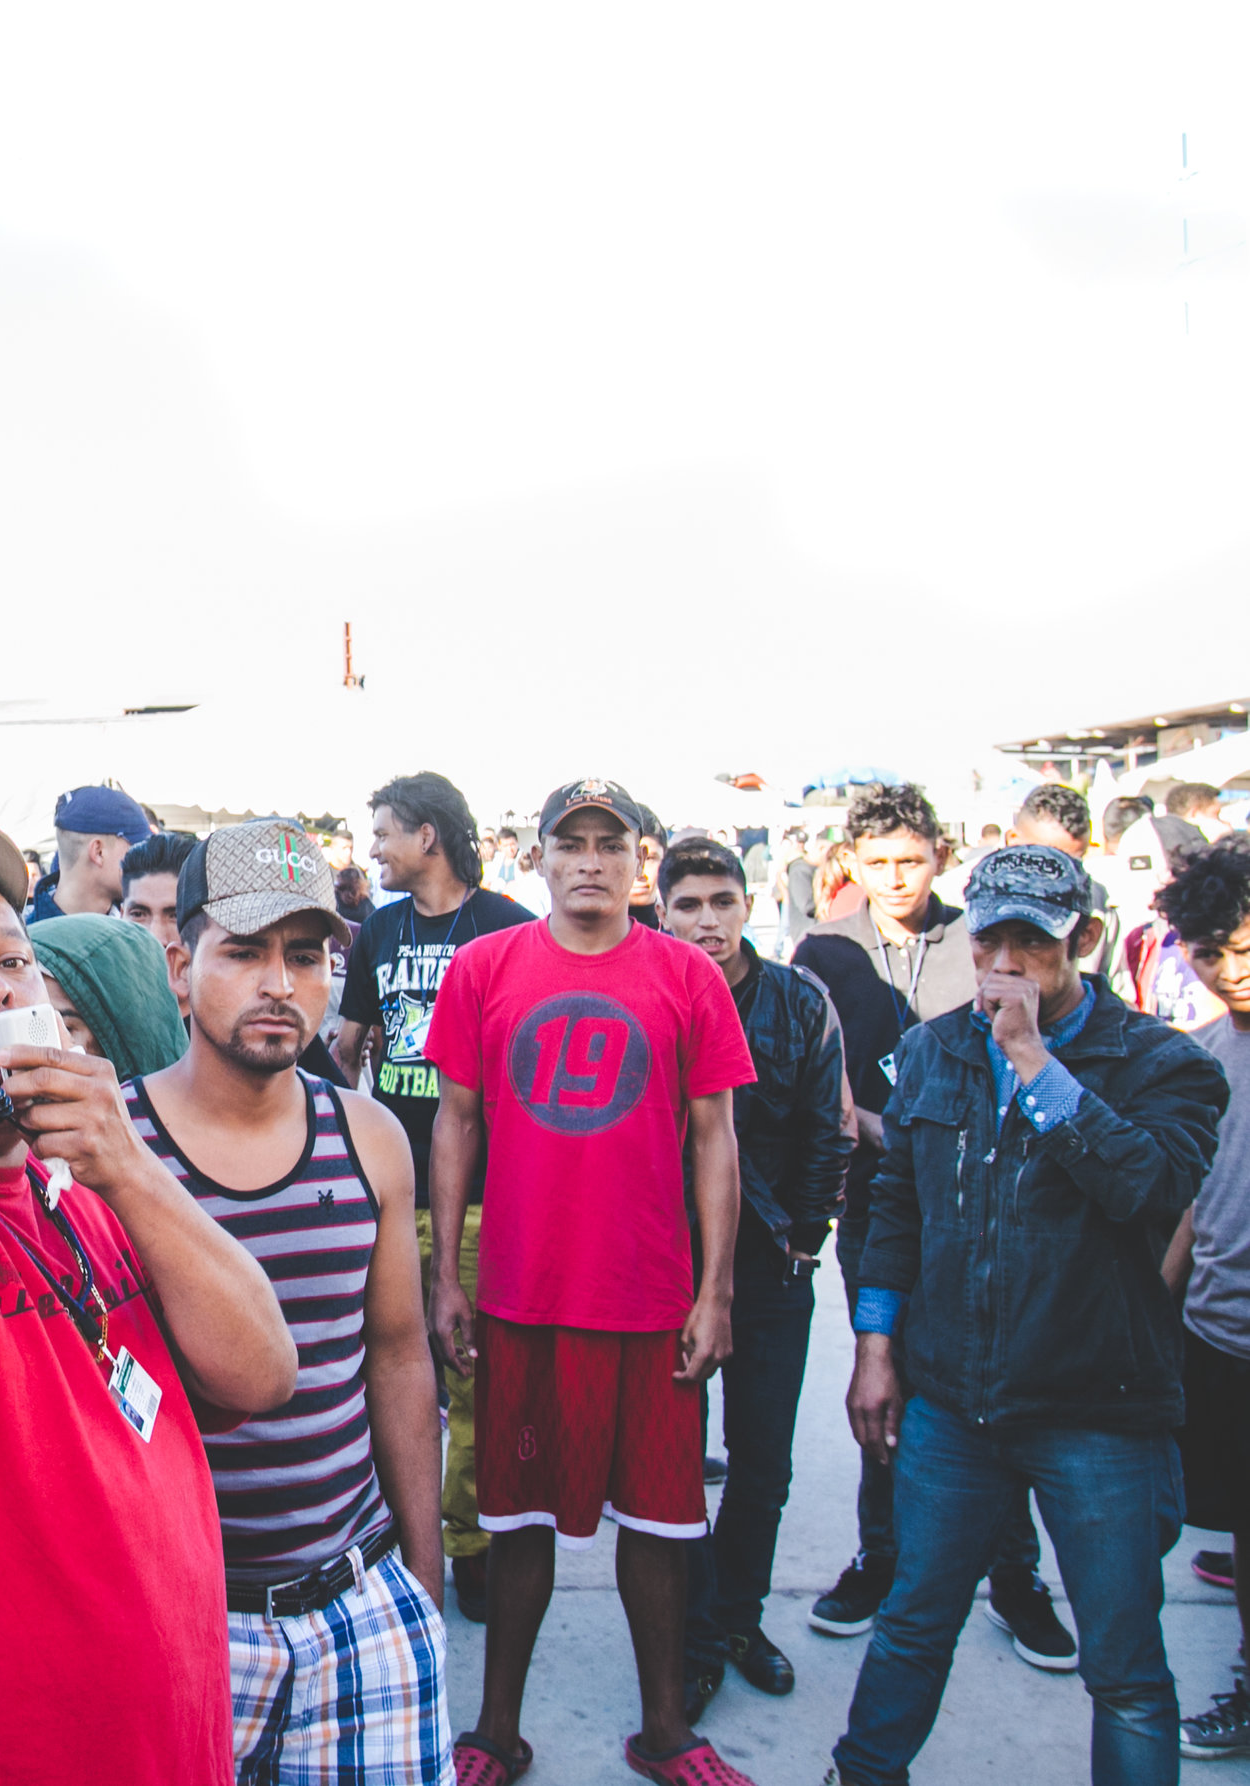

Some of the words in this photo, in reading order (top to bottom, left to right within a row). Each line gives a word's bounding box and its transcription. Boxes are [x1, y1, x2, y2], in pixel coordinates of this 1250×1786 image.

[255, 847, 318, 875] GUCCI
[423, 944, 456, 957] NORTH
[529, 1014, 630, 1109] 19
